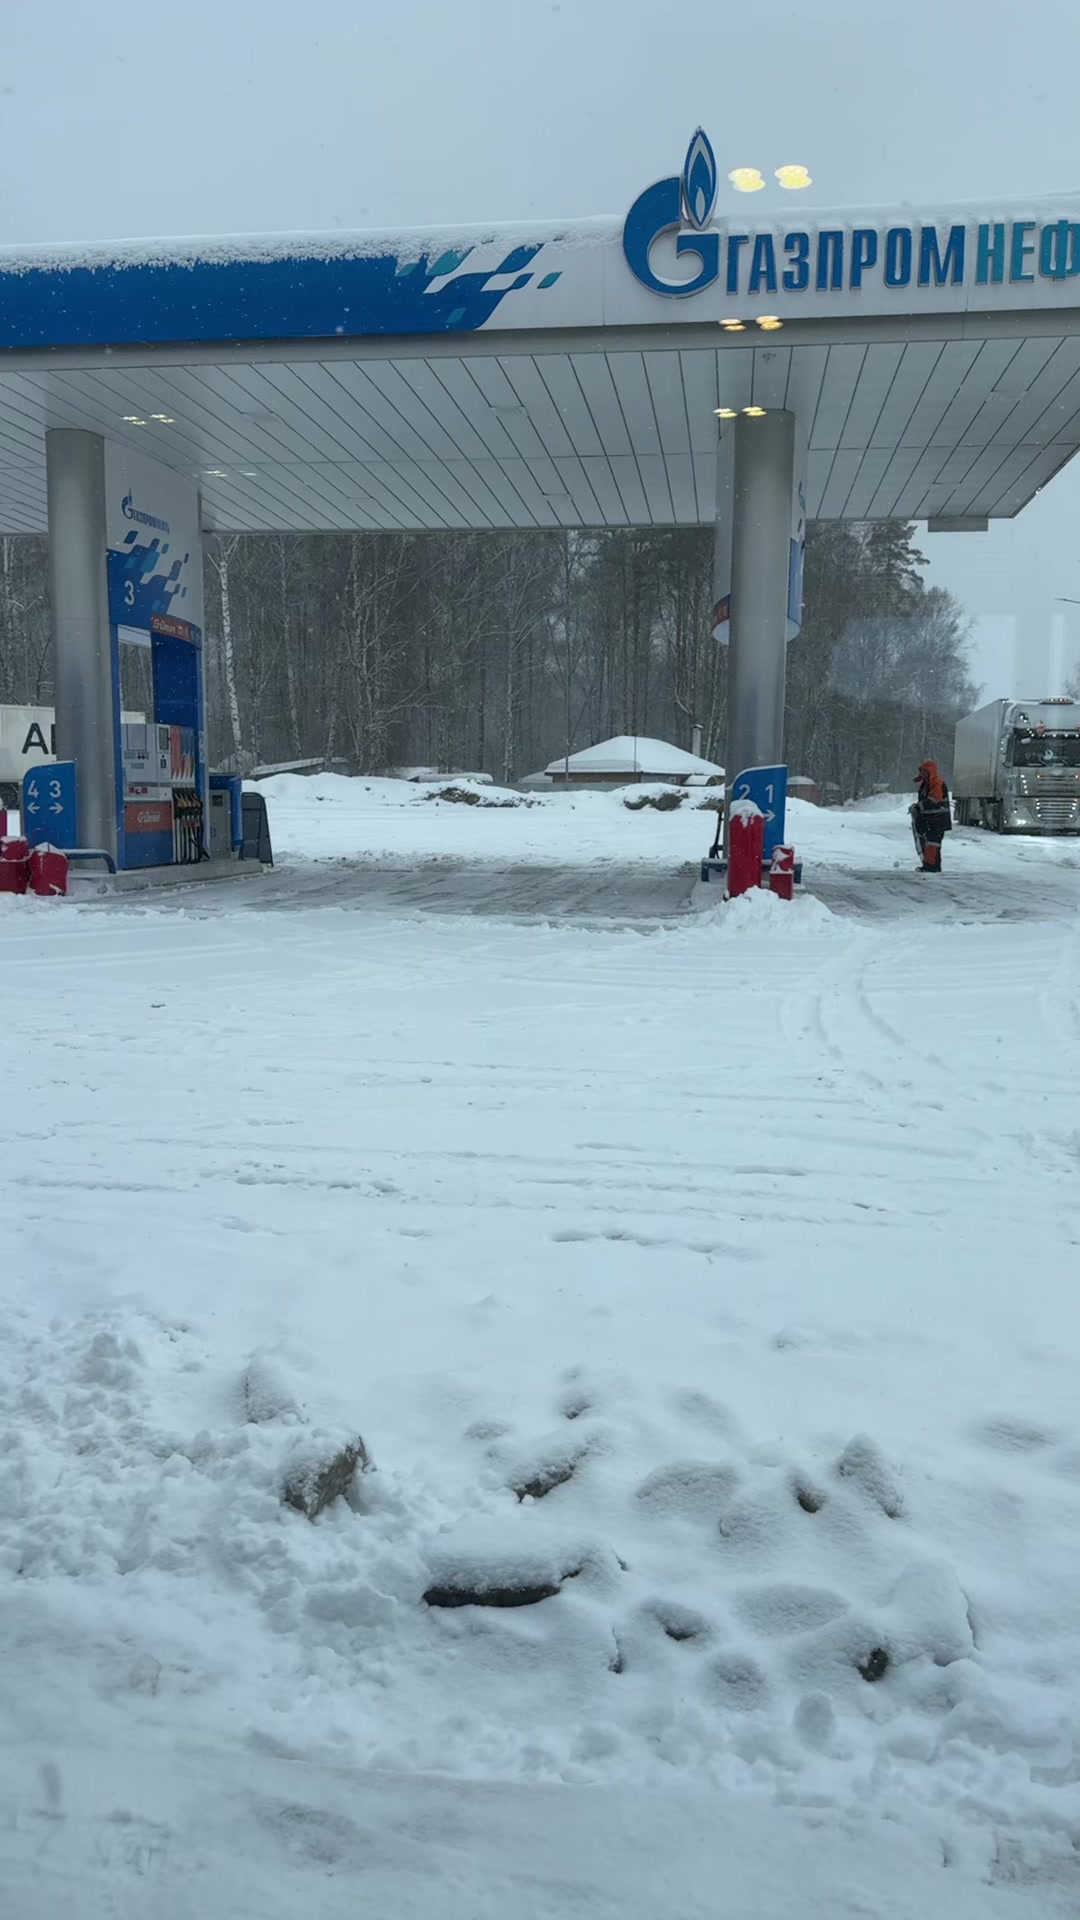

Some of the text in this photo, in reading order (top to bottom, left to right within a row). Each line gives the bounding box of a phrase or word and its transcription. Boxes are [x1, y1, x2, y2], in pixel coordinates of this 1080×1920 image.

[726, 219, 1080, 296] ГАЗПРОМНЕФ
[124, 580, 135, 606] 3
[27, 780, 61, 798] 4 3
[739, 783, 774, 804] 2 1
